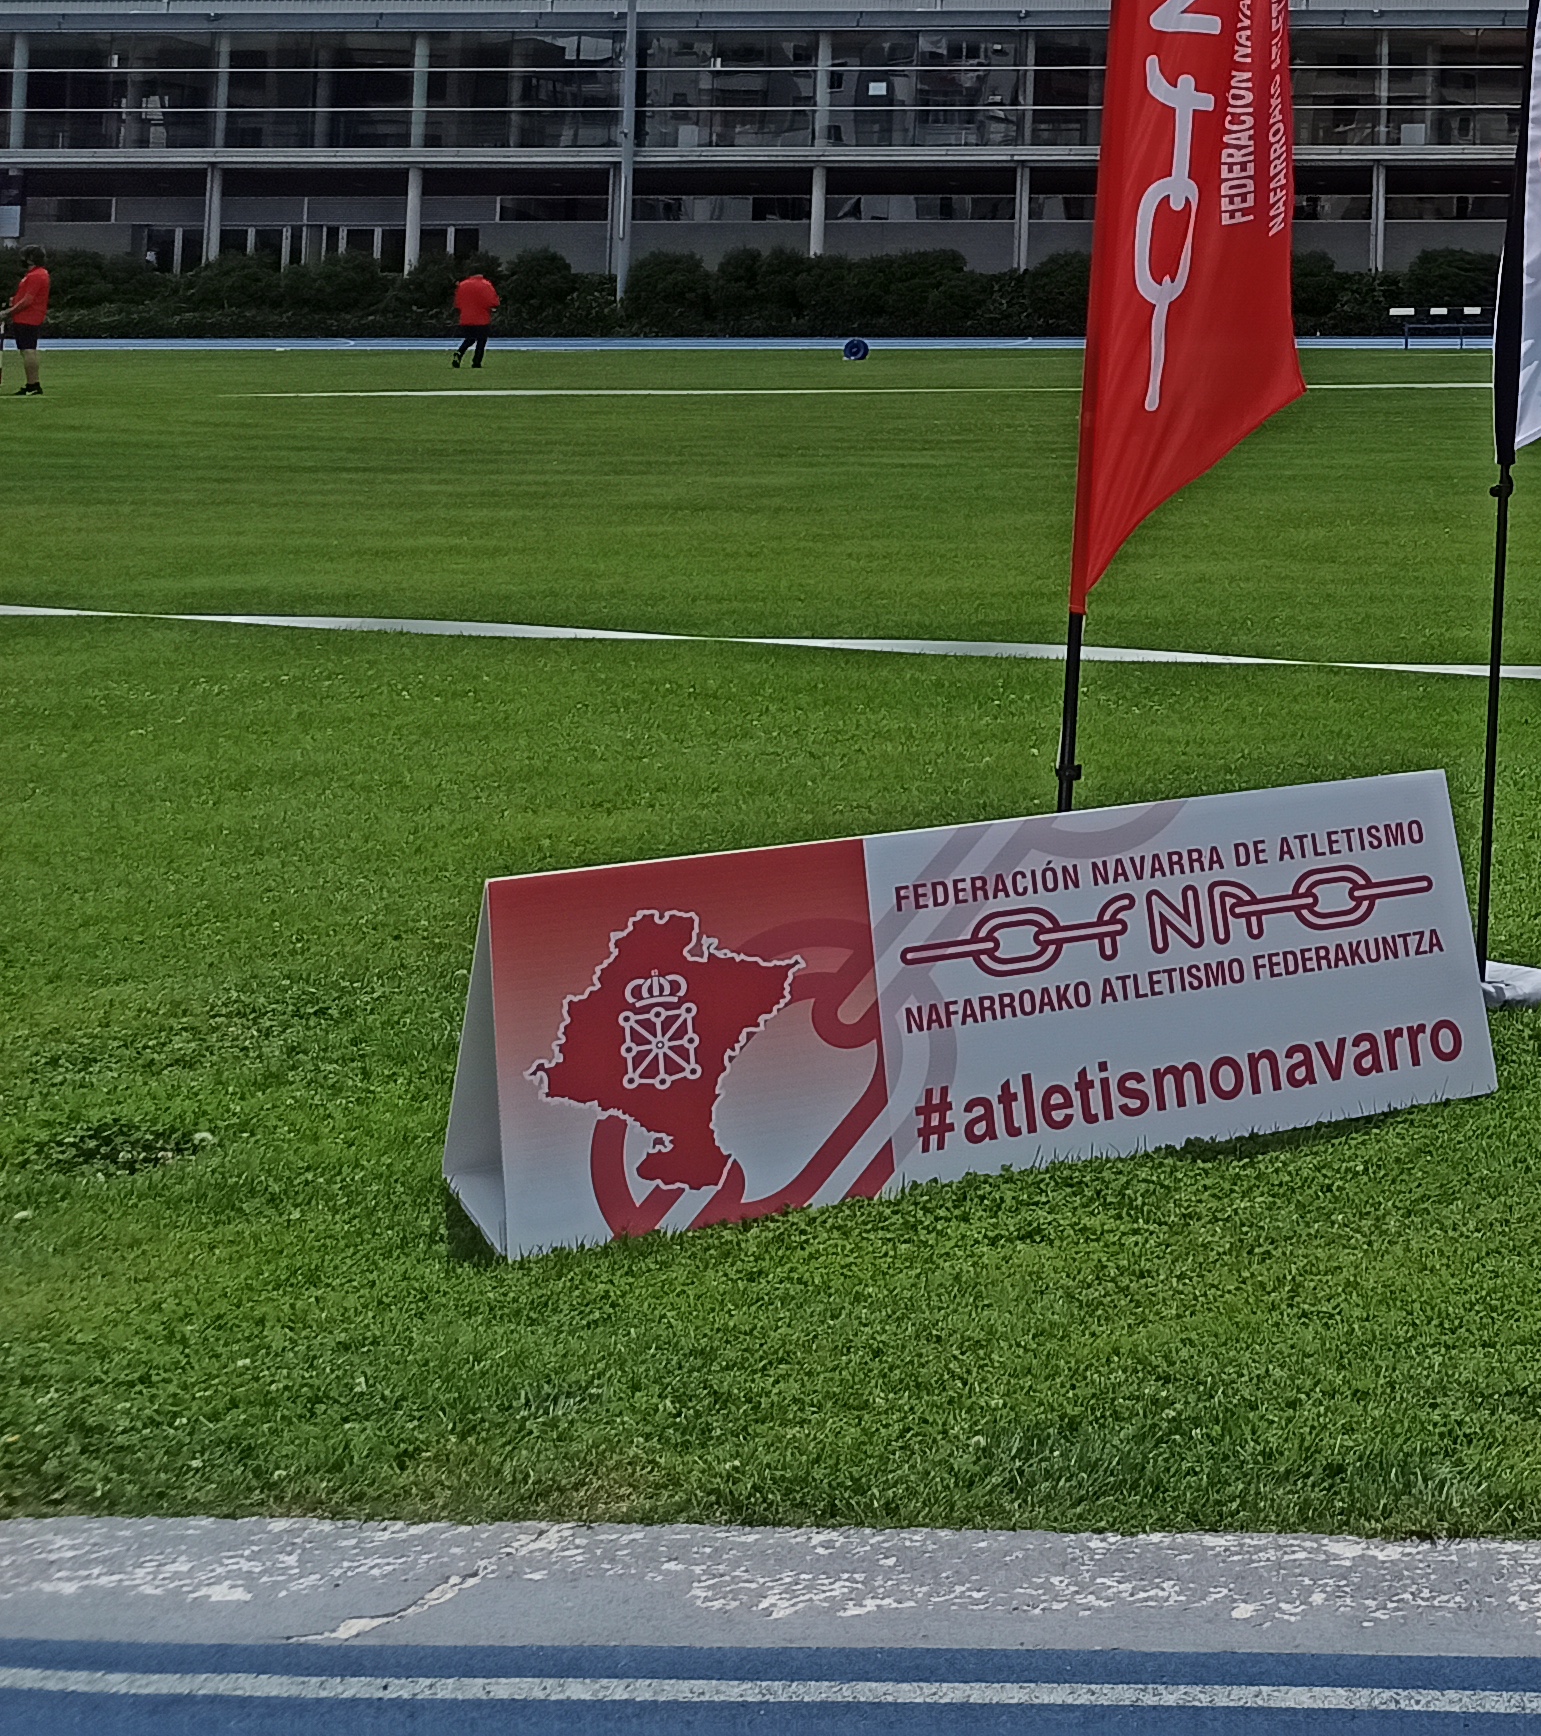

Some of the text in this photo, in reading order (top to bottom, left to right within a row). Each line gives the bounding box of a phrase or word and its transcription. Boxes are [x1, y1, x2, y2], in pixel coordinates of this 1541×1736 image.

[1221, 70, 1255, 225] FEDERACIÓN
[895, 819, 1424, 913] FEDERACIÓN NAVARRA DE ATLETISMO
[904, 929, 1444, 1035] NAFARROAKO ATLETISMO FEDERAKUNTZA
[916, 1018, 1464, 1154] #atletismonavarro
